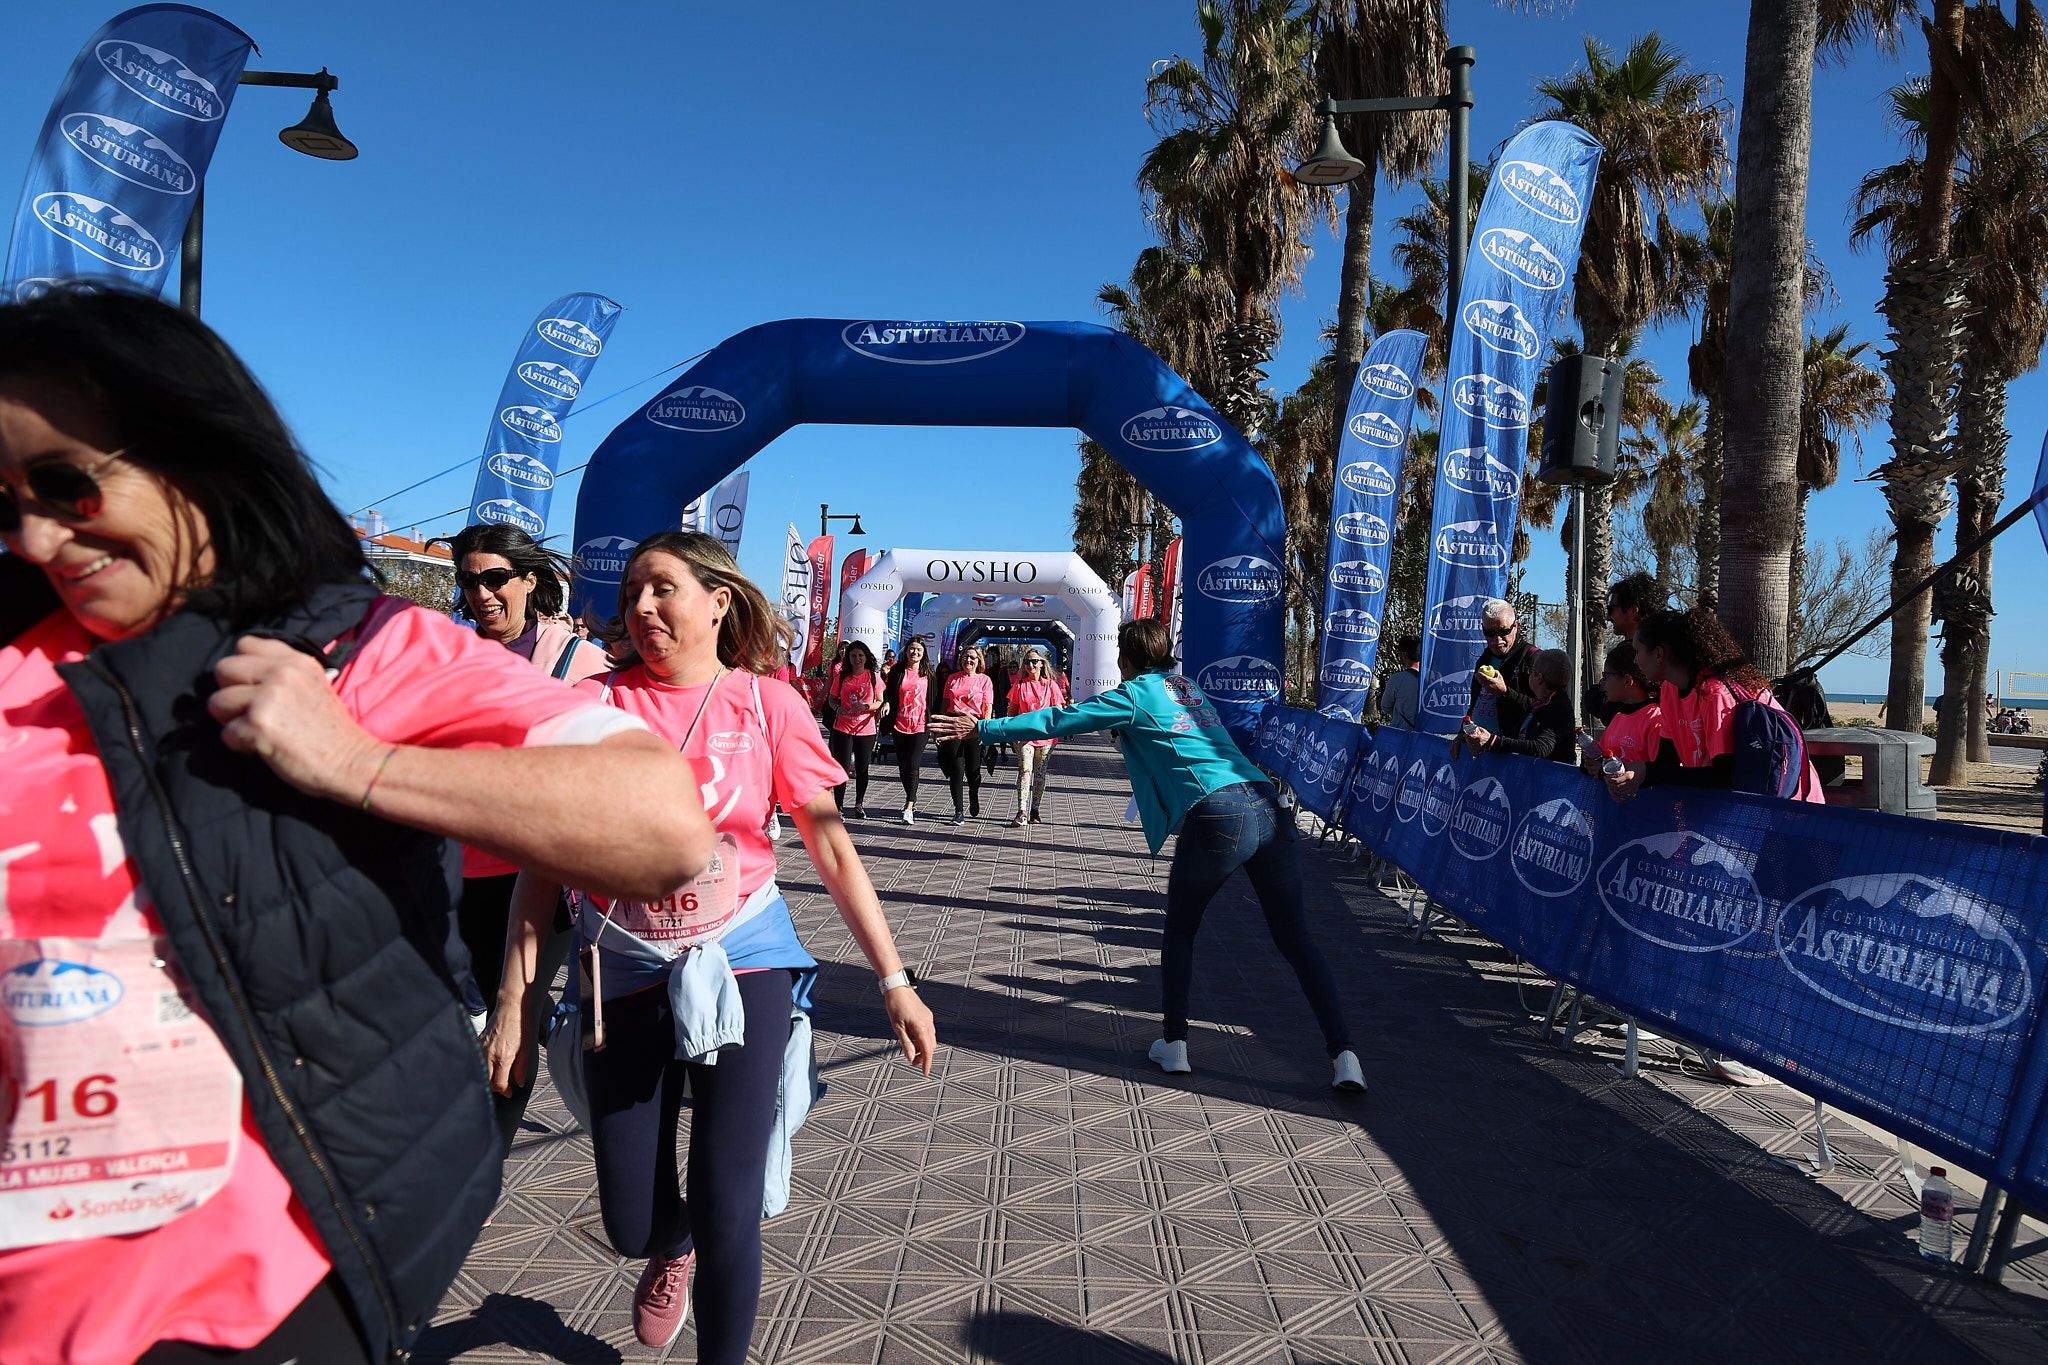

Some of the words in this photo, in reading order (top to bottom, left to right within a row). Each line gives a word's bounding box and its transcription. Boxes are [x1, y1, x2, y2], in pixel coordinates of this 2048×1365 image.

[102, 47, 213, 118] ASTURIANA
[71, 120, 185, 191] ASTURIANA
[1503, 171, 1575, 219] ASTURIANA
[43, 200, 152, 267] ASTURIANA
[1486, 235, 1556, 286] ASTURIANA
[541, 322, 597, 354] ASTURIANA
[854, 323, 1012, 345] ASTURIANA
[522, 365, 578, 397] ASTURIANA
[1364, 372, 1408, 395] ASTURIANA
[652, 403, 738, 422] ASTURIANA
[1129, 424, 1216, 441] ASTURIANA
[1353, 420, 1399, 443] ASTURIANA
[492, 458, 550, 487] ASTURIANA
[1345, 469, 1391, 492] ASTURIANA
[481, 505, 539, 532] ASTURIANA
[813, 552, 825, 611] Santander
[926, 559, 1037, 584] OYSHO
[1203, 572, 1279, 591] ASTURIANA
[860, 582, 894, 592] OYSHO
[1068, 587, 1102, 595] OYSHO
[843, 626, 875, 635] OYSHO
[1085, 633, 1117, 641] OYSHO
[1328, 618, 1378, 637] ASTURIANA
[1084, 679, 1116, 687] OYSHO
[1203, 672, 1279, 691] ASTURIANA
[1323, 669, 1370, 686] ASTURIANA
[1452, 797, 1503, 847] ASTURIANA
[1514, 823, 1585, 883] ASTURIANA
[1637, 860, 1685, 883] CENTRAL
[1689, 874, 1746, 897] LECHERA
[647, 892, 699, 913] 016
[1604, 857, 1746, 936] ASTURIANA
[659, 919, 683, 928] 1721
[659, 931, 669, 939] LA
[669, 929, 692, 938] MUJER
[696, 918, 725, 933] VALENCIA
[1832, 908, 1906, 938] CENTRAL
[1915, 930, 2006, 966] LECHERA
[1786, 905, 2002, 1018] ASTURIANA
[80, 1187, 185, 1218] Santander
